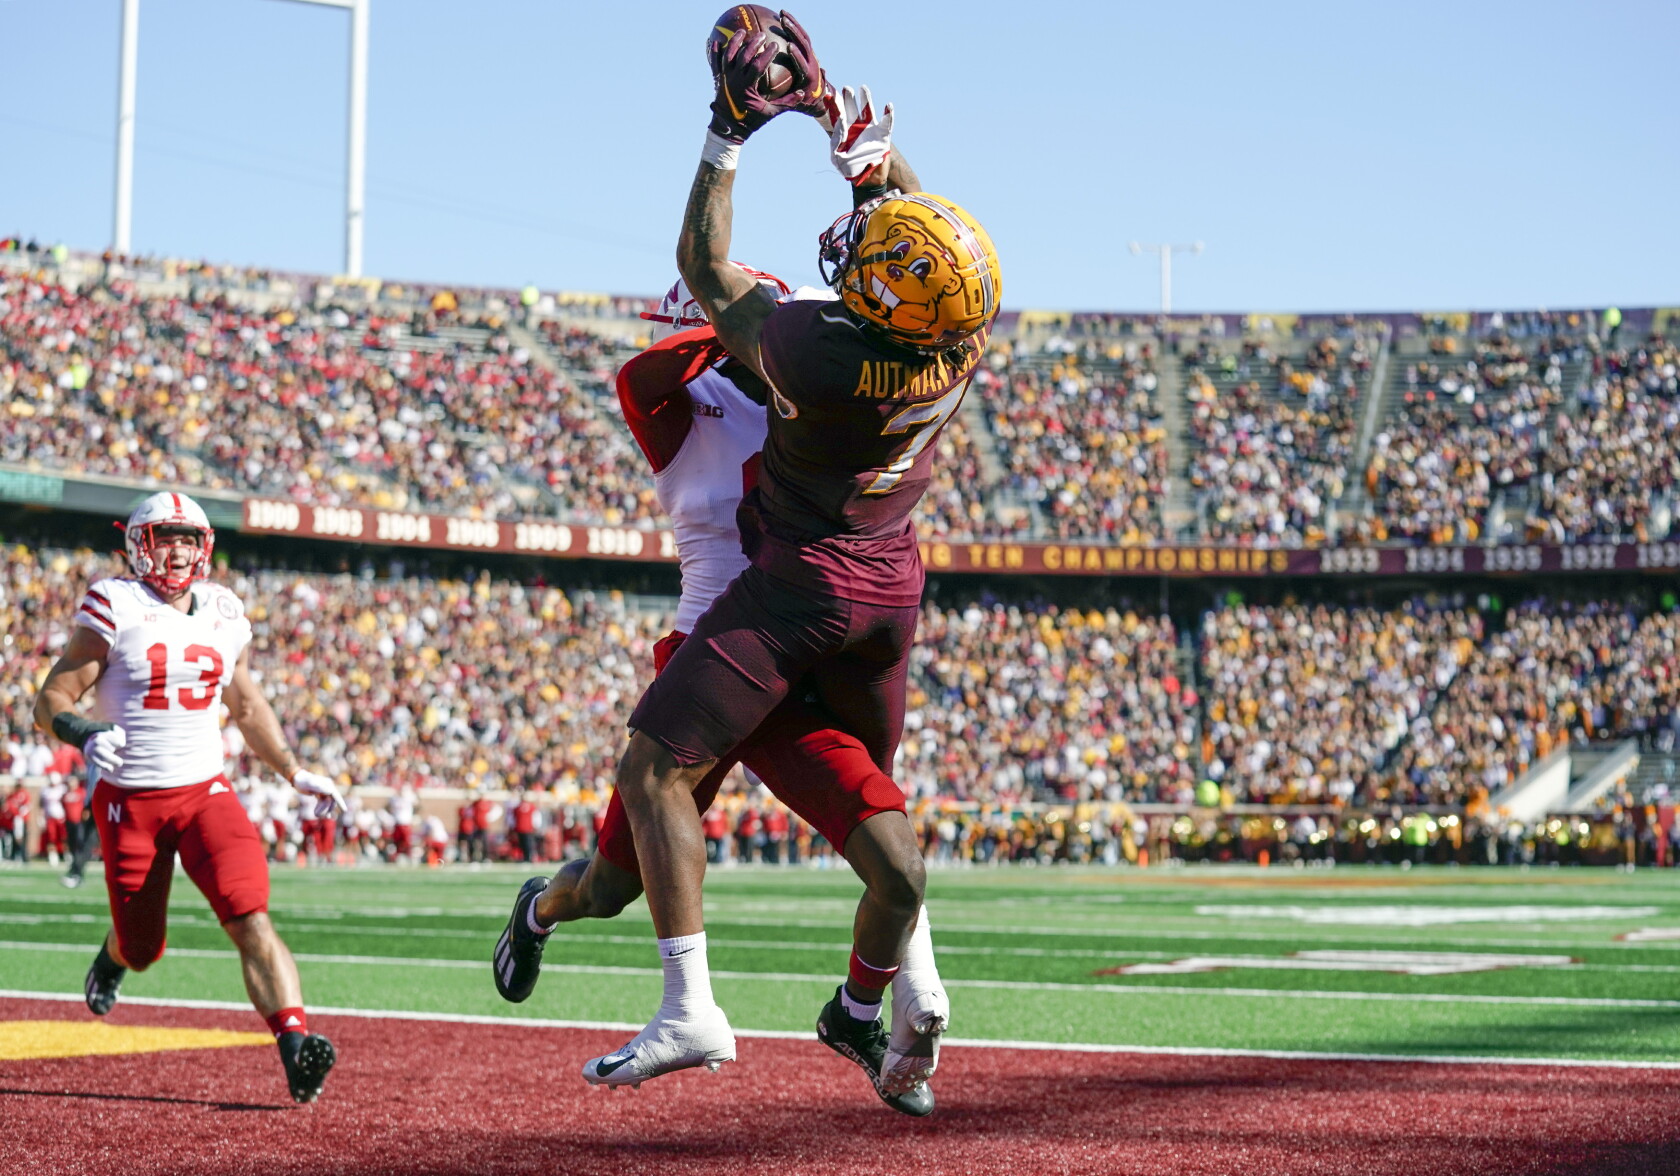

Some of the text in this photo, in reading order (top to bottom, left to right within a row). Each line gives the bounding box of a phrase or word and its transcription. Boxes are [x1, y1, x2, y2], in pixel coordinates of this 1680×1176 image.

[862, 377, 969, 495] 7
[918, 543, 1289, 573] IG TEN CHAMPIONSHIPS
[1637, 542, 1680, 567] 193
[143, 642, 224, 710] 13
[107, 802, 122, 824] N
